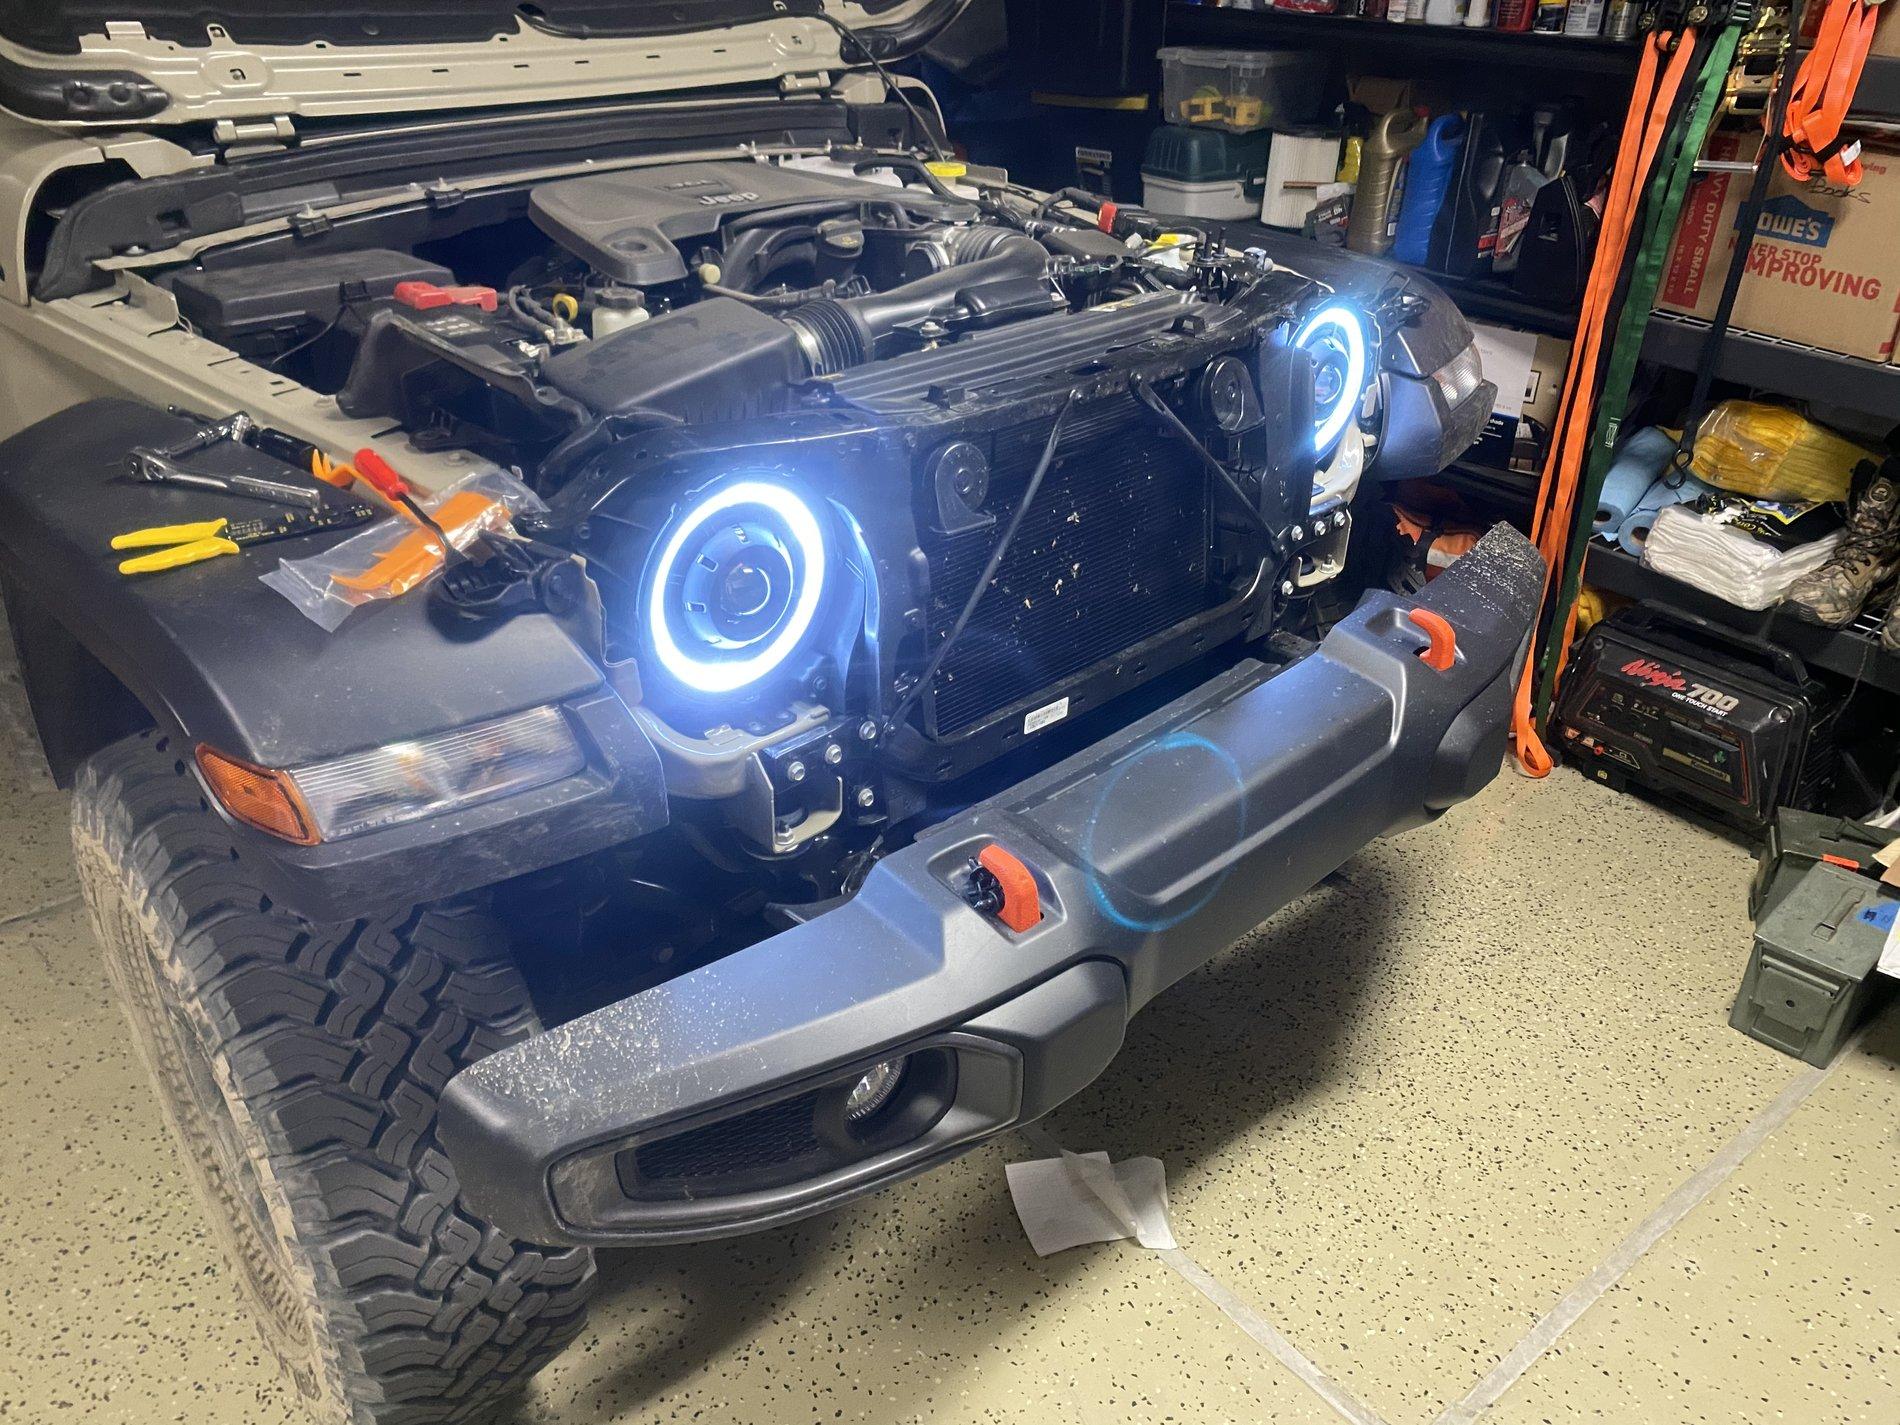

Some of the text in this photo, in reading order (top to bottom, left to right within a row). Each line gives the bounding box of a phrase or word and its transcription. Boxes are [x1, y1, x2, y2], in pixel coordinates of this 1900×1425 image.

[699, 192, 759, 205] Jeep
[1700, 202, 1716, 242] DUTY
[1756, 212, 1822, 241] OWE'S
[1683, 246, 1705, 294] SMALL
[1781, 248, 1822, 266] STOP
[1745, 254, 1882, 300] MPROVING
[1621, 659, 1739, 711] Ninja 700
[1671, 692, 1728, 717] ONE TOUCH START
